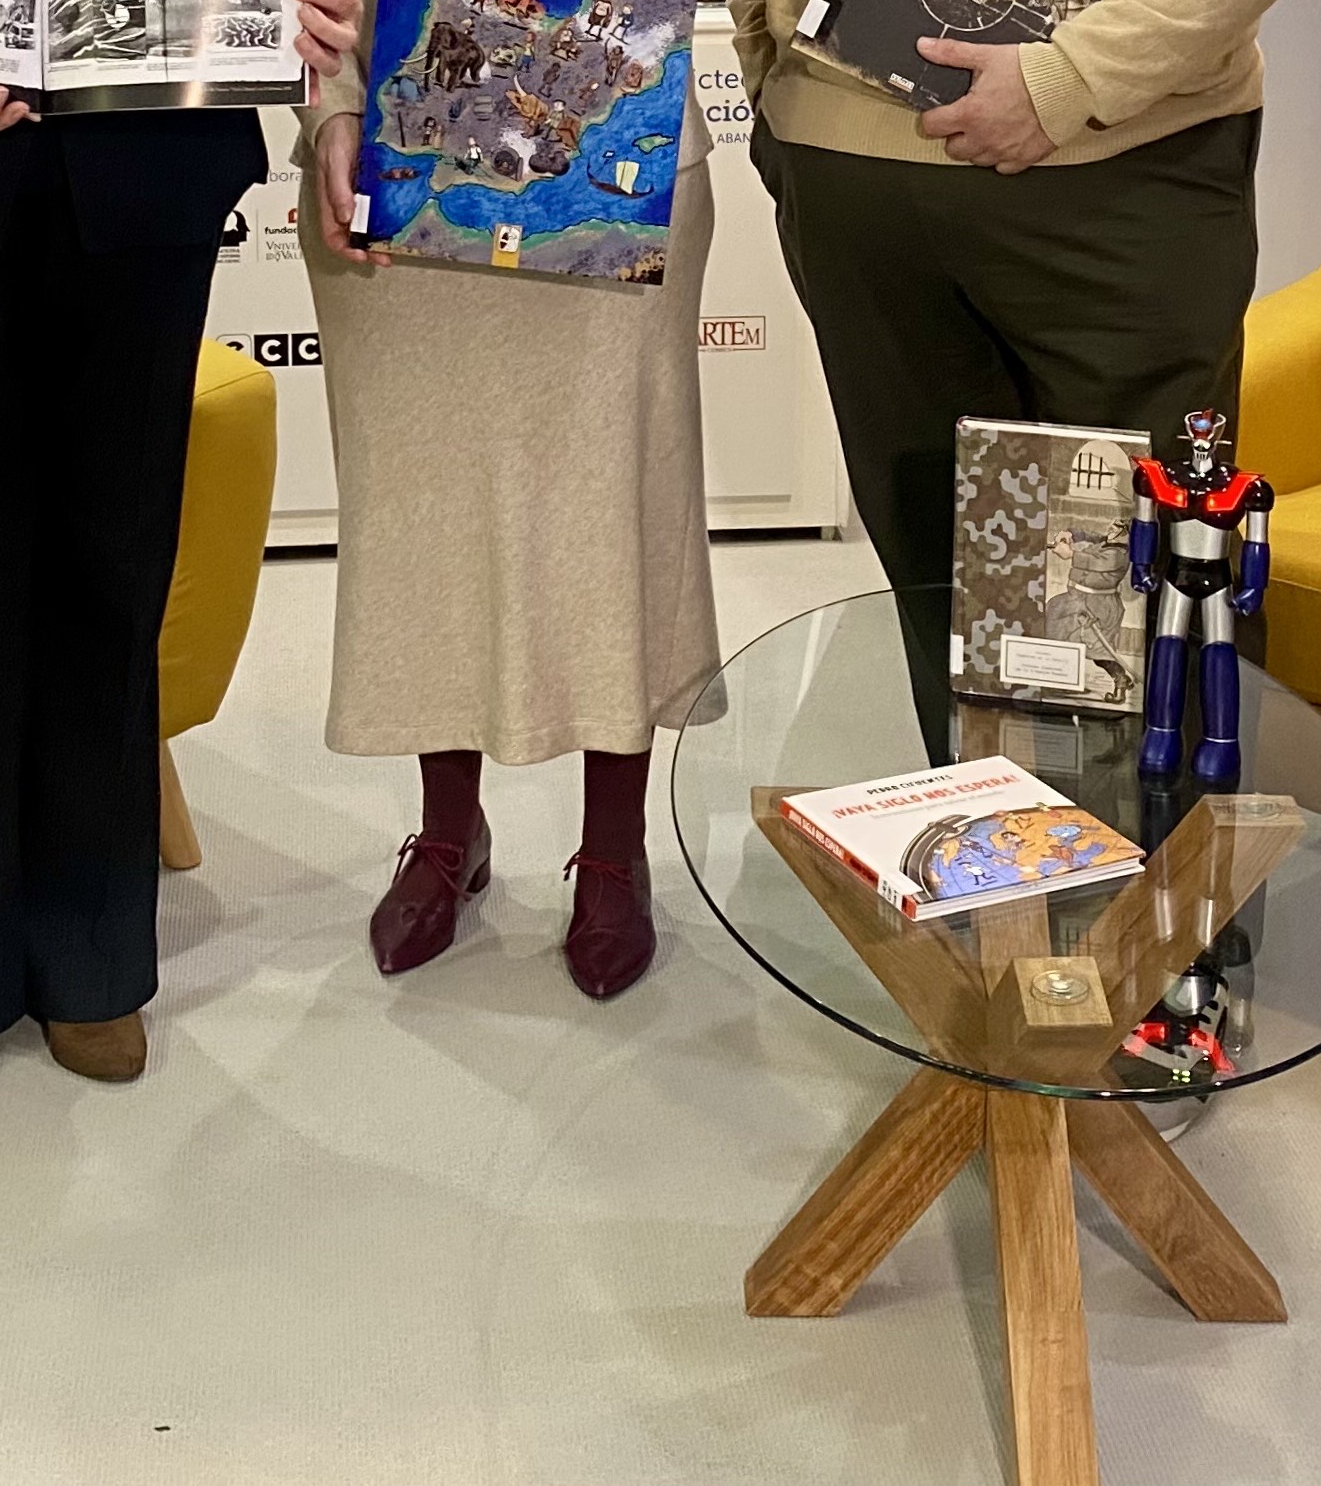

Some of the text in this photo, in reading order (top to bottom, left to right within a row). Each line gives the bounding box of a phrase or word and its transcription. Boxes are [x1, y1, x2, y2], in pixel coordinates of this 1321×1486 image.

[717, 133, 751, 143] ABAN
[877, 793, 924, 810] SIGLO
[923, 784, 956, 800] NOS
